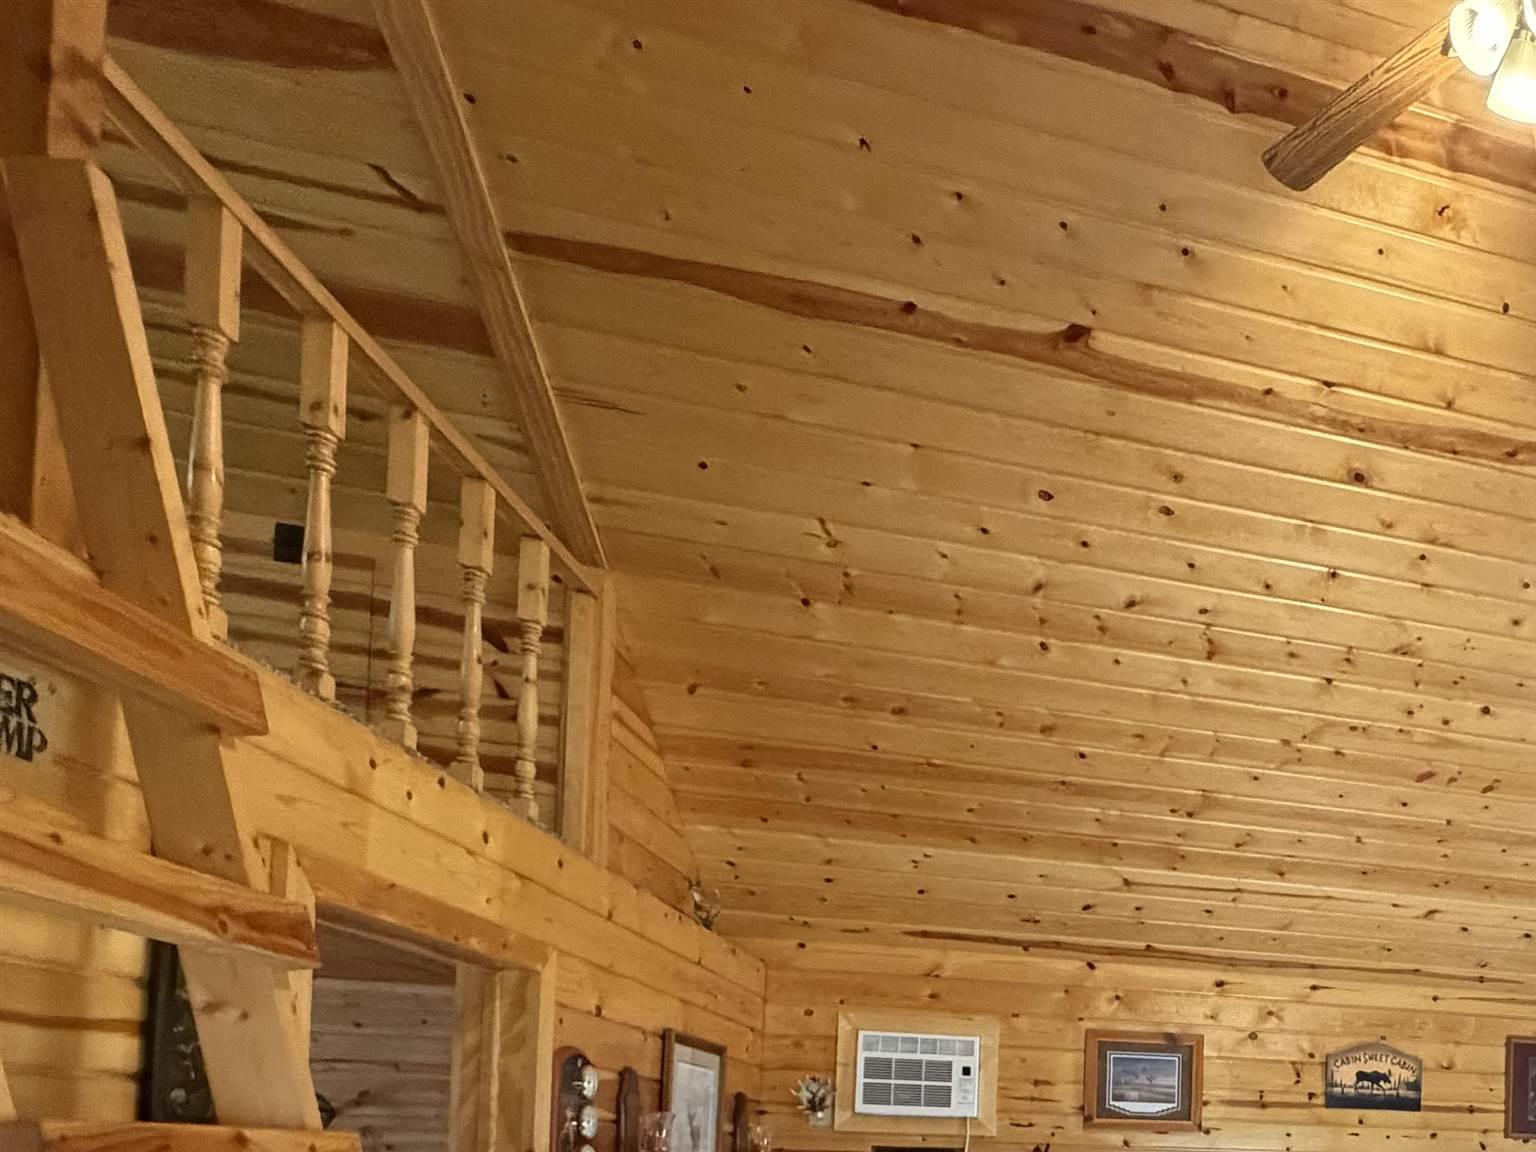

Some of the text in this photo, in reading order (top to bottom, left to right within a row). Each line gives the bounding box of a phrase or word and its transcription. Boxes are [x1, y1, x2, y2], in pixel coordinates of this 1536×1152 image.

[1334, 1052, 1417, 1074] CABIN SWEET CABIN
